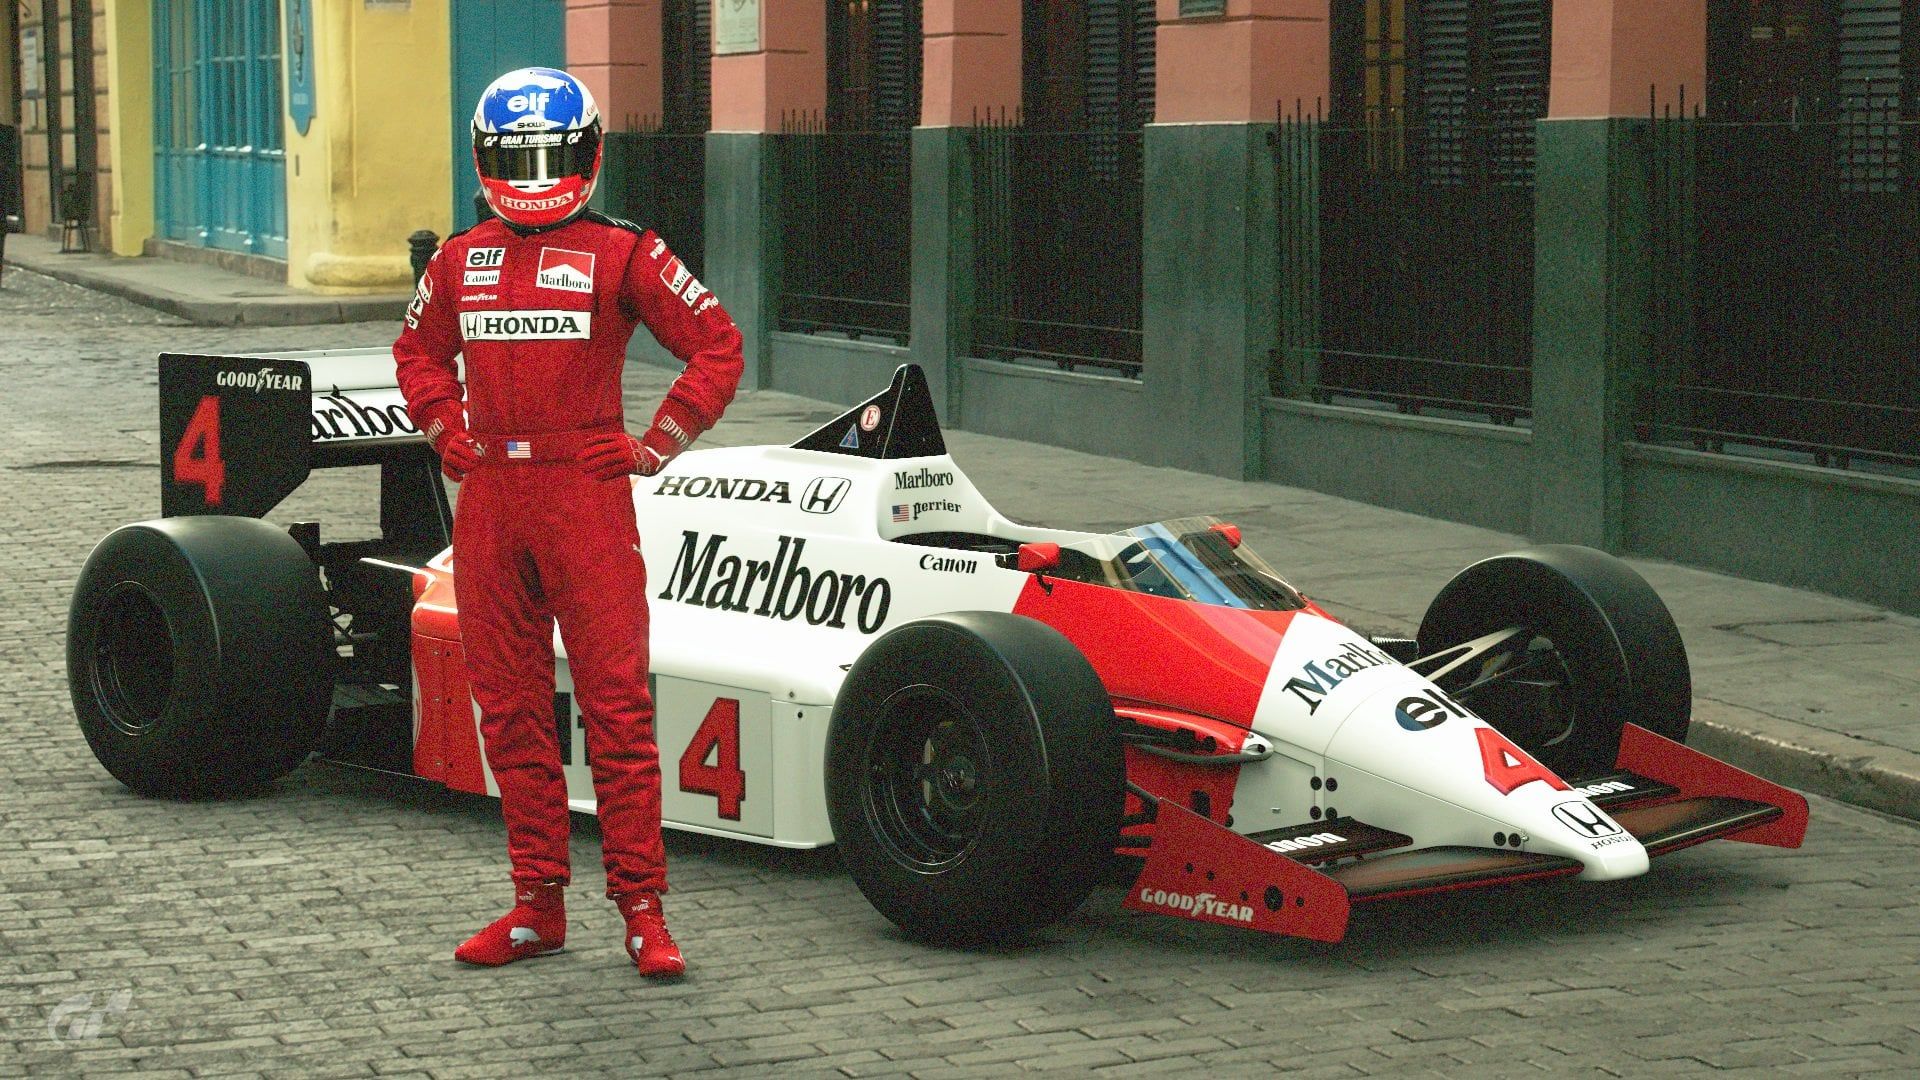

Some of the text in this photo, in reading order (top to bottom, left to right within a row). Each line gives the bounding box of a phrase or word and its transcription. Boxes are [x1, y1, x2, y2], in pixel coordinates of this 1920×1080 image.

[507, 93, 549, 112] elf
[501, 134, 562, 144] GRAN TURISMO
[503, 196, 573, 210] HONDA
[470, 249, 502, 265] elf
[465, 274, 498, 283] Canon
[539, 273, 591, 290] Marlboro
[484, 316, 581, 334] HONDA
[216, 368, 302, 393] GOODYEAR
[312, 396, 420, 439] arlbo
[174, 396, 225, 506] 4
[653, 475, 792, 503] HONDA
[894, 468, 954, 490] Marlboro
[919, 554, 978, 575] Canon
[658, 530, 892, 634] Marlboro
[680, 697, 746, 822] 4
[1140, 888, 1254, 922] GOODYEAR
